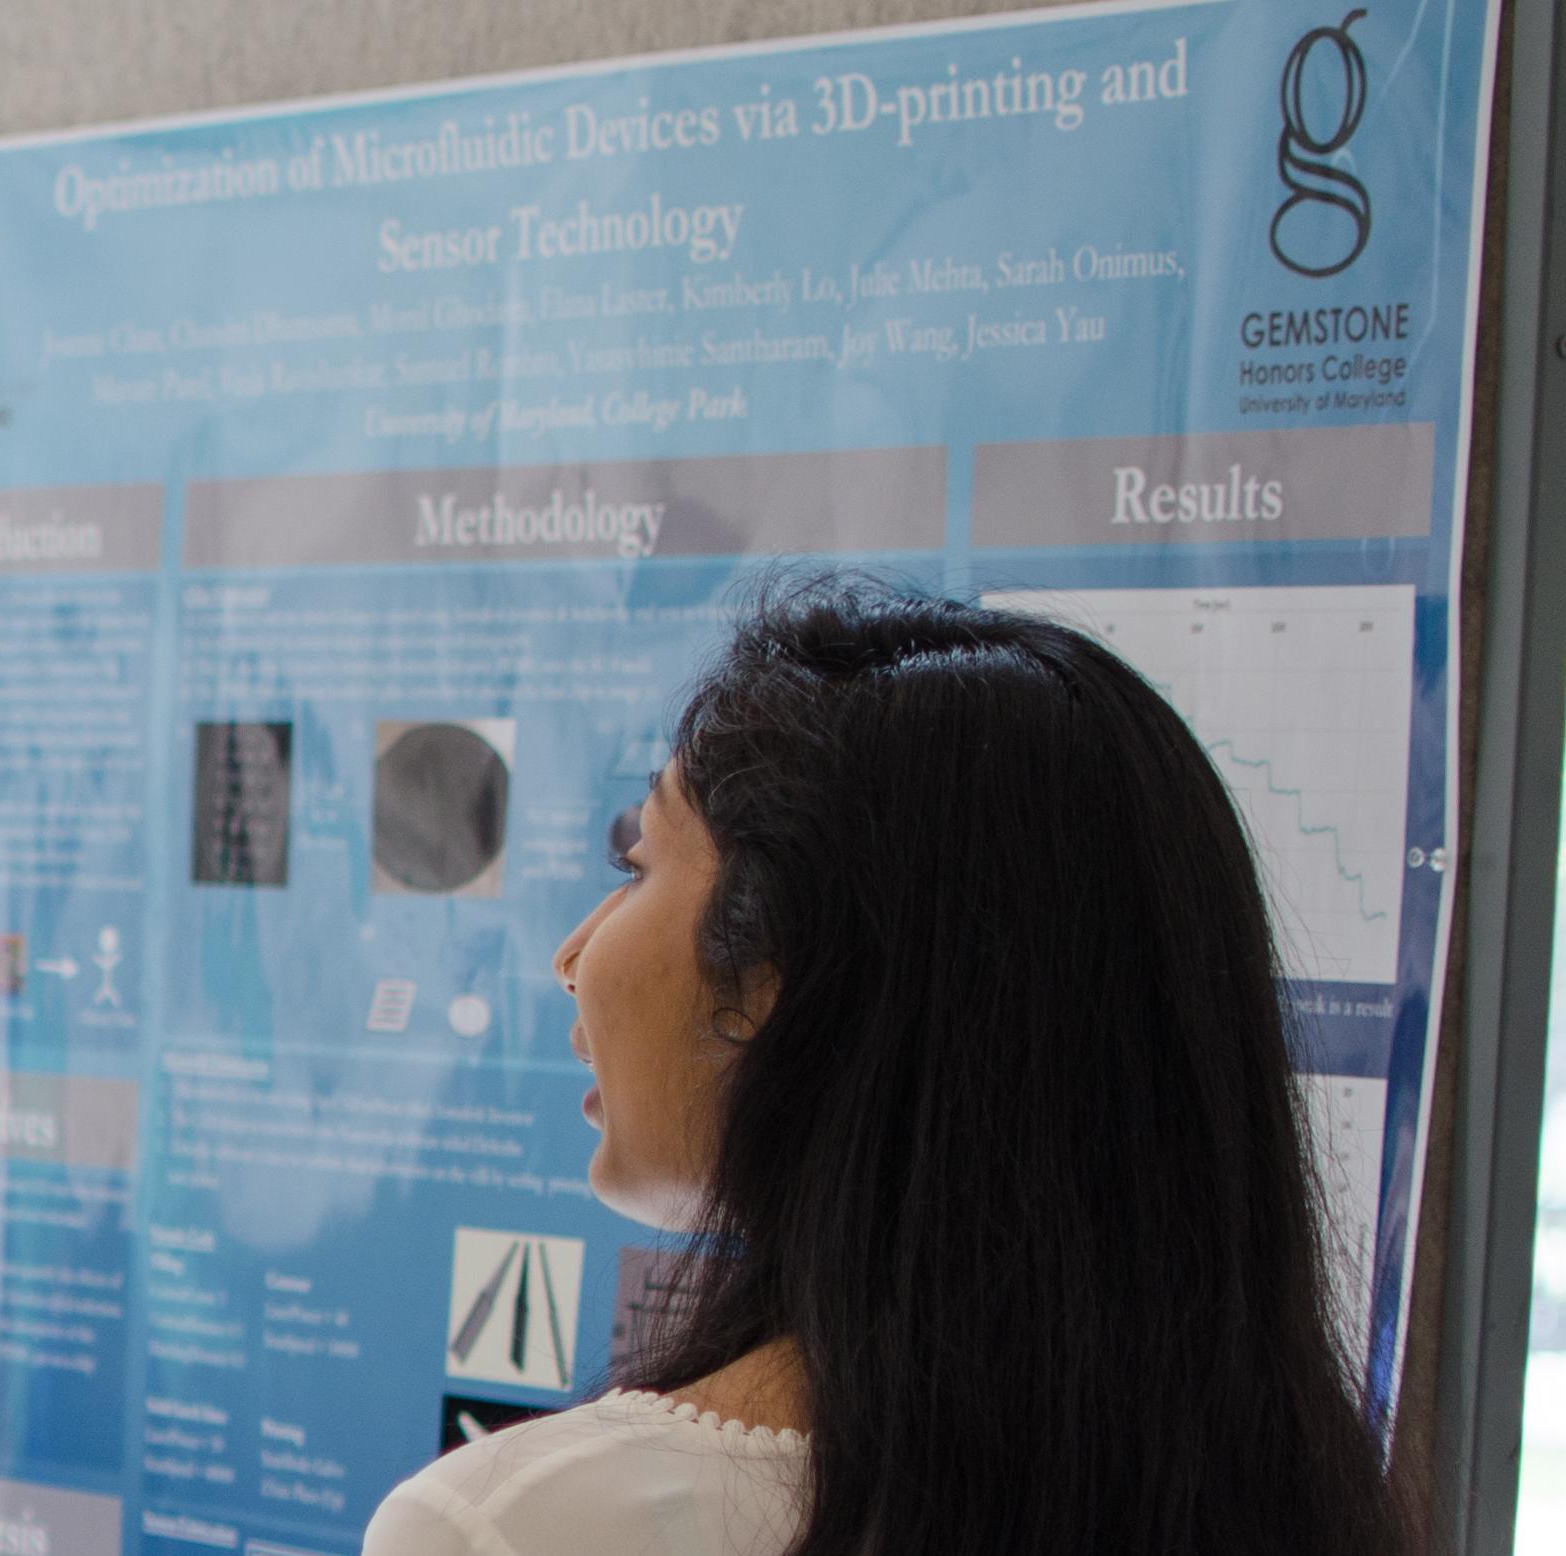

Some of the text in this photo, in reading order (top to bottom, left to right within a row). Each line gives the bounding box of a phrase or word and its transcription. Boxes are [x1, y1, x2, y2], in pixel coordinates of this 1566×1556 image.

[54, 37, 1189, 232] Optimization of Microfluidic Devices via 3D-printing and
[376, 193, 744, 273] Sensor Technology
[682, 270, 792, 314] Kimberly
[996, 247, 1066, 288] Sarah
[1072, 242, 1185, 281] Onimus,
[885, 318, 960, 361] Wang,
[965, 309, 1047, 361] Jessica
[1055, 305, 1106, 343] Yau
[1240, 303, 1410, 349] GEMSTONE
[1239, 353, 1408, 387] Honors College
[686, 384, 748, 421] Park
[414, 486, 666, 558] Methodology
[1109, 463, 1285, 526] Results
